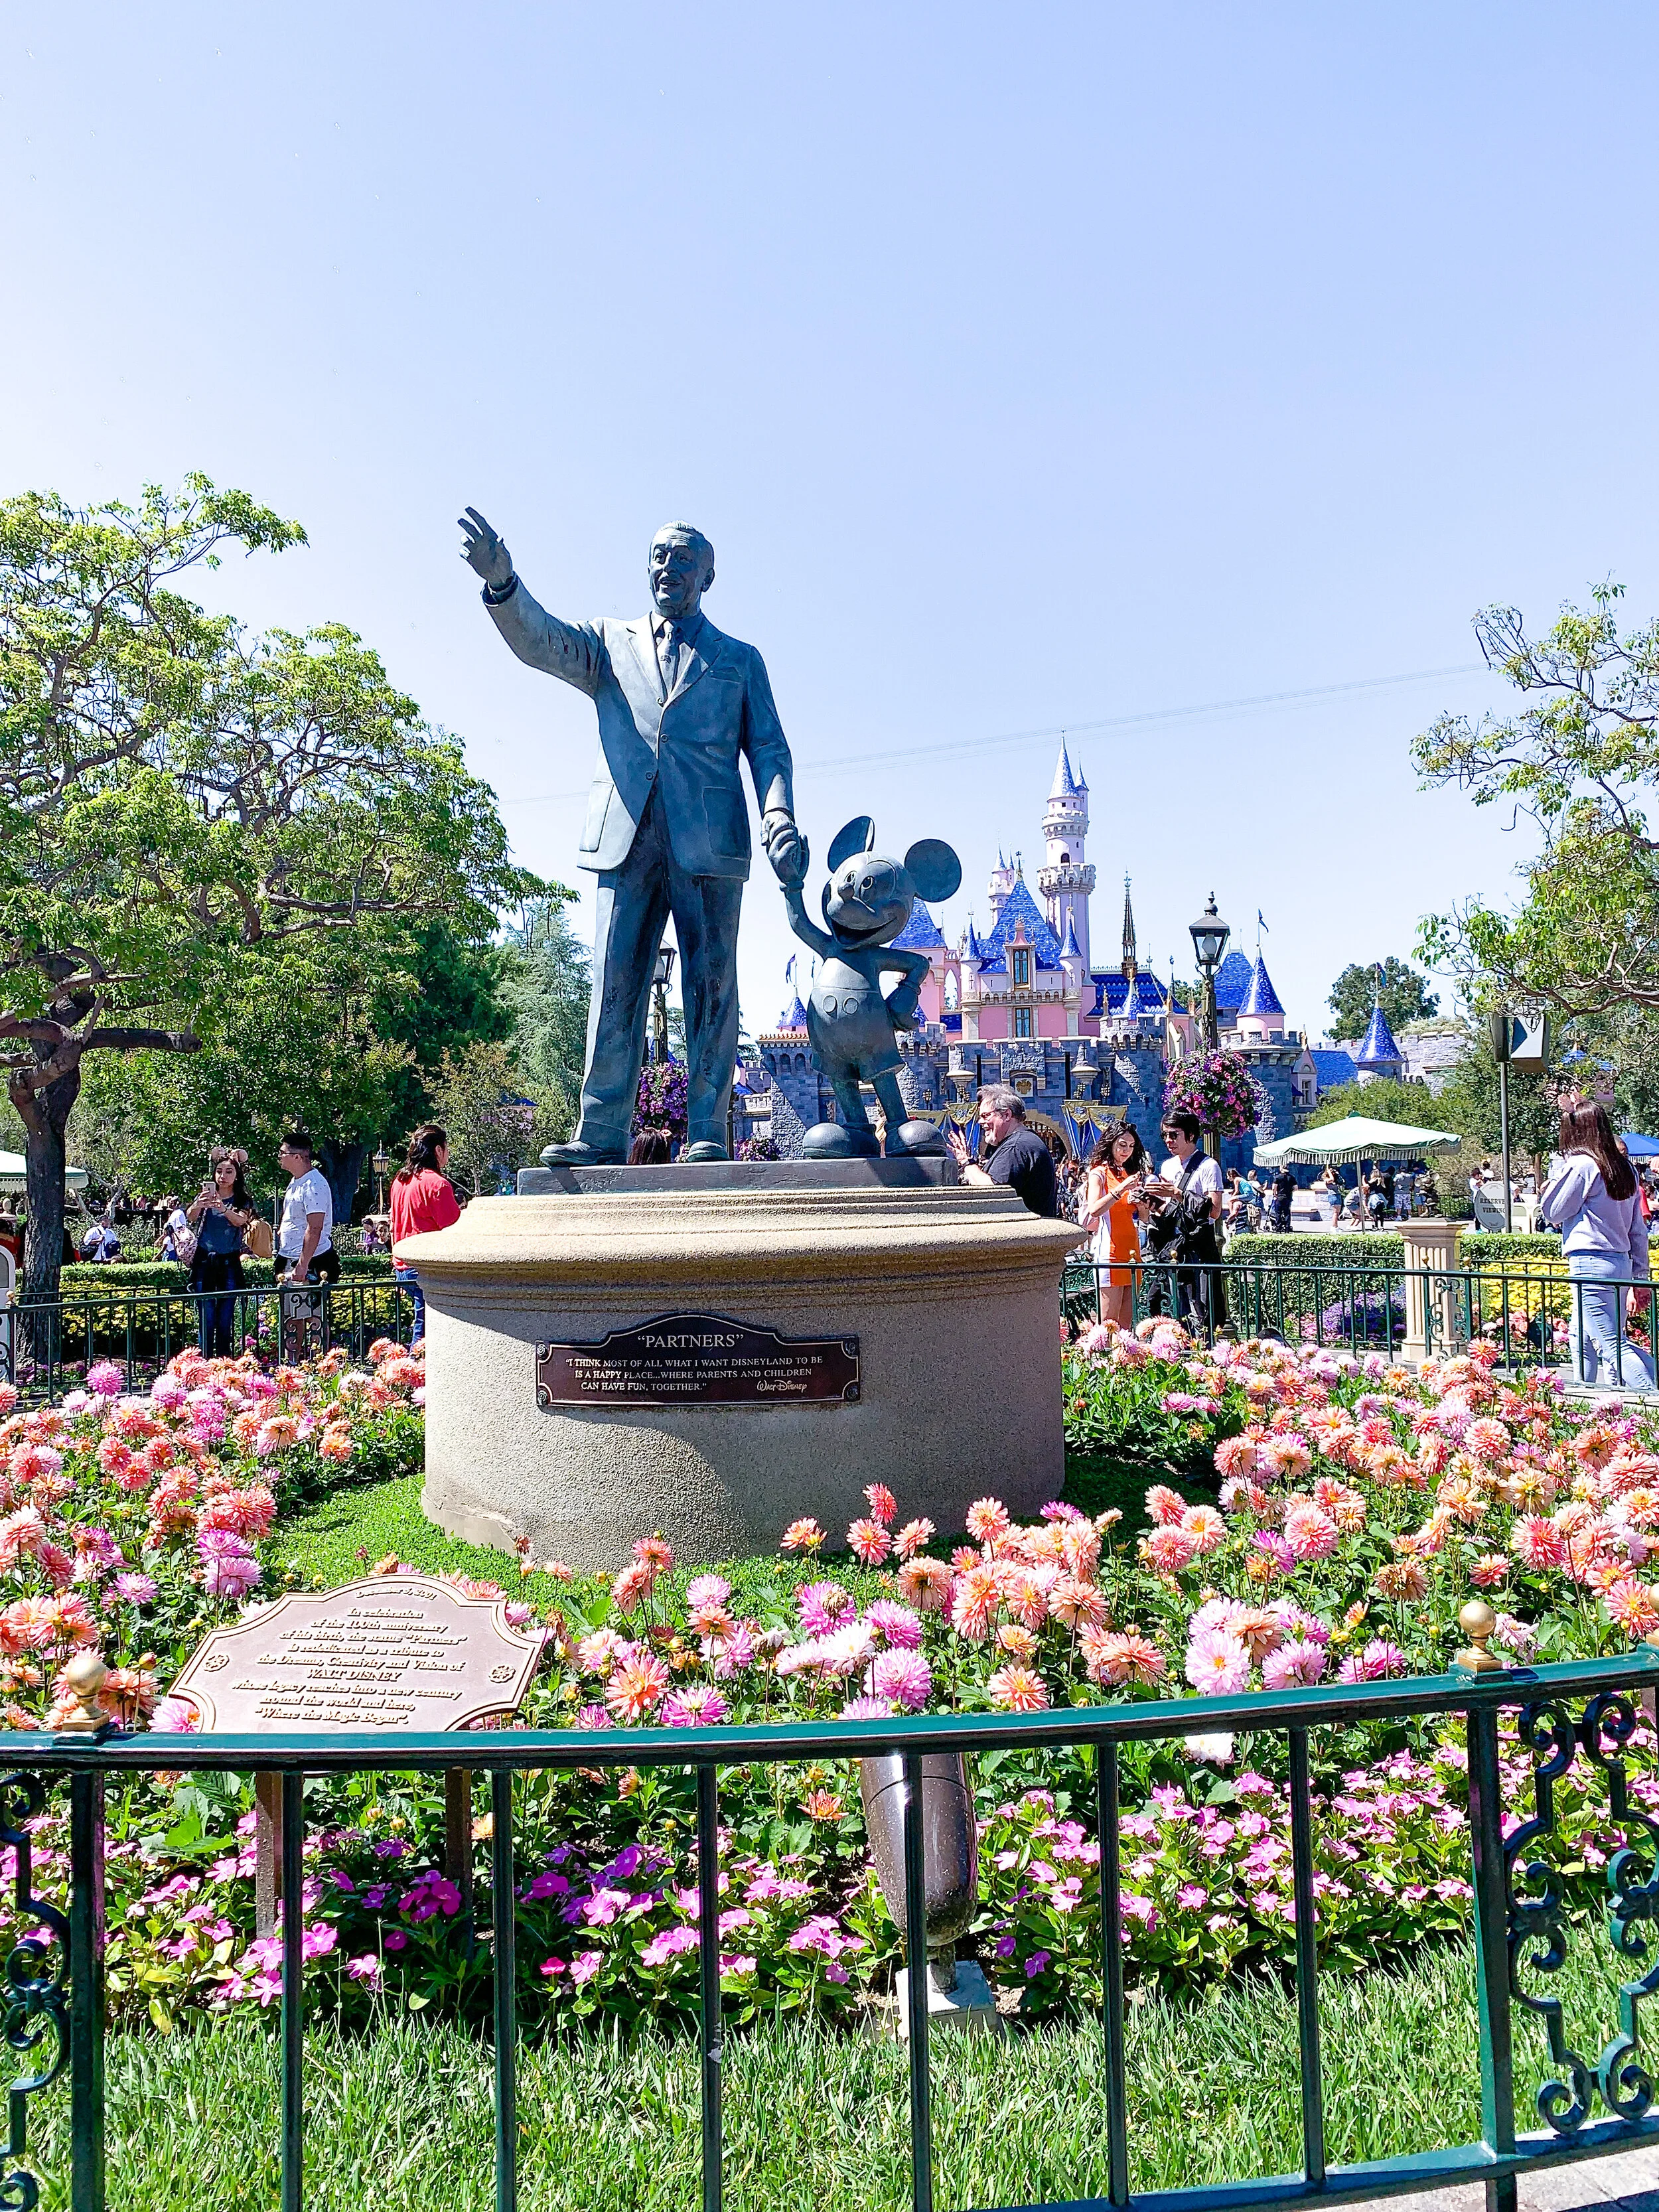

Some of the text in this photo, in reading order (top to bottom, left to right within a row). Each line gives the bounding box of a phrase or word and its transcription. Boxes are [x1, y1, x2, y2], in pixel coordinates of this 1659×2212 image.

[638, 1334, 744, 1348] “PARTNERS”
[575, 1359, 601, 1367] THINK
[731, 1357, 792, 1366] DISNEYLAND
[593, 1370, 621, 1379] HAPPY
[764, 1368, 812, 1377] CHILDREN
[581, 1382, 599, 1390] CAN
[601, 1382, 625, 1390] HAVE
[627, 1382, 648, 1392] FUN,
[347, 1608, 423, 1619] In celebration
[311, 1619, 448, 1634] of the 100th anniversary
[279, 1631, 296, 1639] of
[293, 1631, 313, 1640] his
[313, 1631, 344, 1642] birth,
[347, 1633, 367, 1641] the
[368, 1634, 403, 1643] statue
[287, 1644, 299, 1653] is
[300, 1644, 366, 1655] rededicated
[390, 1647, 429, 1657] tribute
[256, 1655, 277, 1664] the
[327, 1657, 386, 1670] Creativity
[386, 1659, 410, 1668] and
[413, 1660, 449, 1670] Vision
[450, 1662, 466, 1672] of
[307, 1669, 402, 1682] WALT DISNEY
[232, 1680, 268, 1690] whose
[268, 1681, 306, 1694] legacy
[306, 1683, 350, 1694] reaches
[351, 1685, 377, 1695] into
[415, 1690, 463, 1701] century
[259, 1696, 416, 1712] around the world and here,
[301, 1710, 323, 1720] the
[322, 1711, 360, 1724] Magic
